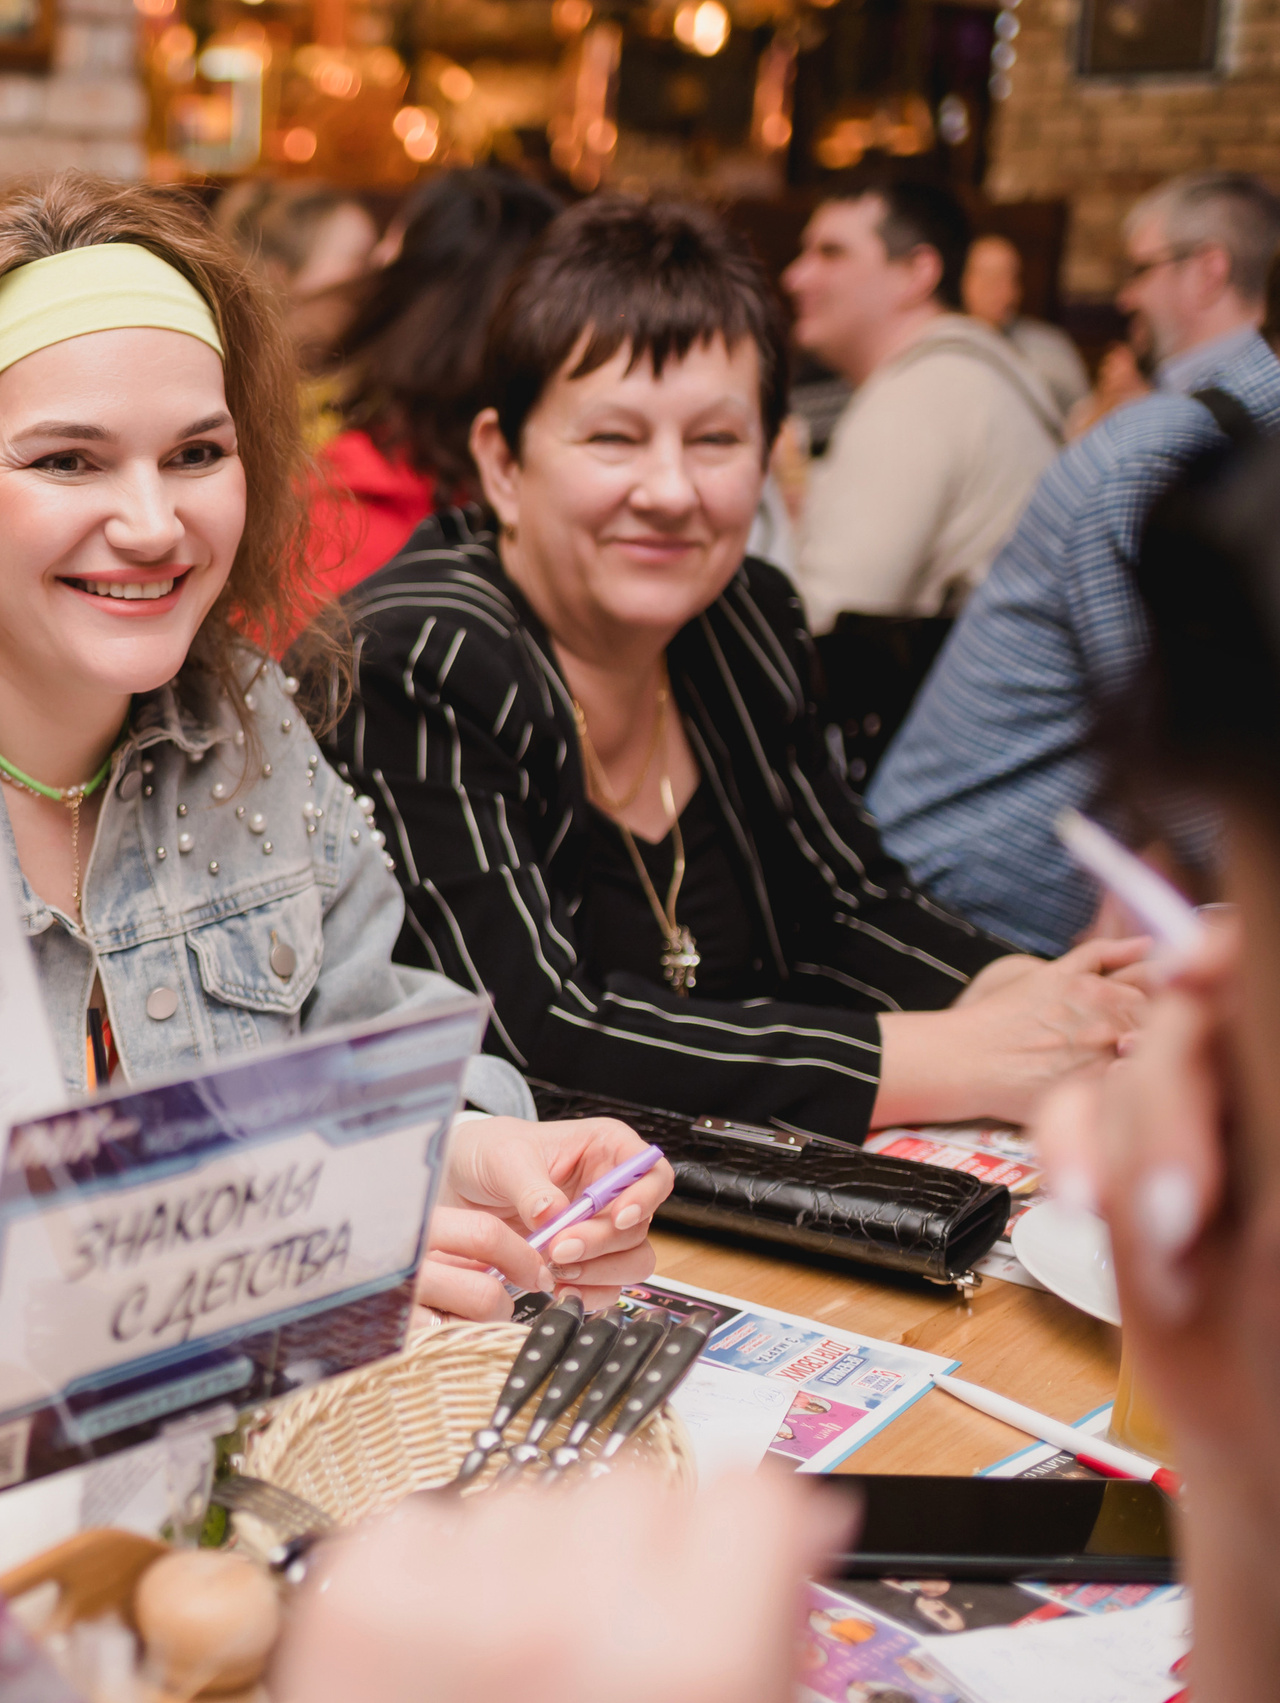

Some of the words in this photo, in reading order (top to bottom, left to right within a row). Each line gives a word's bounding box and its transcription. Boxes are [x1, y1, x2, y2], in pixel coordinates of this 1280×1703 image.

[66, 1160, 324, 1284] ЗНАКОМЫ
[110, 1284, 148, 1341] С
[151, 1218, 354, 1341] ДЕТСТВА
[756, 1341, 792, 1363] МАРТА
[810, 1339, 851, 1360] ДЛЯ
[775, 1354, 829, 1382] СВОИХ
[1031, 1455, 1074, 1476] МАРТА
